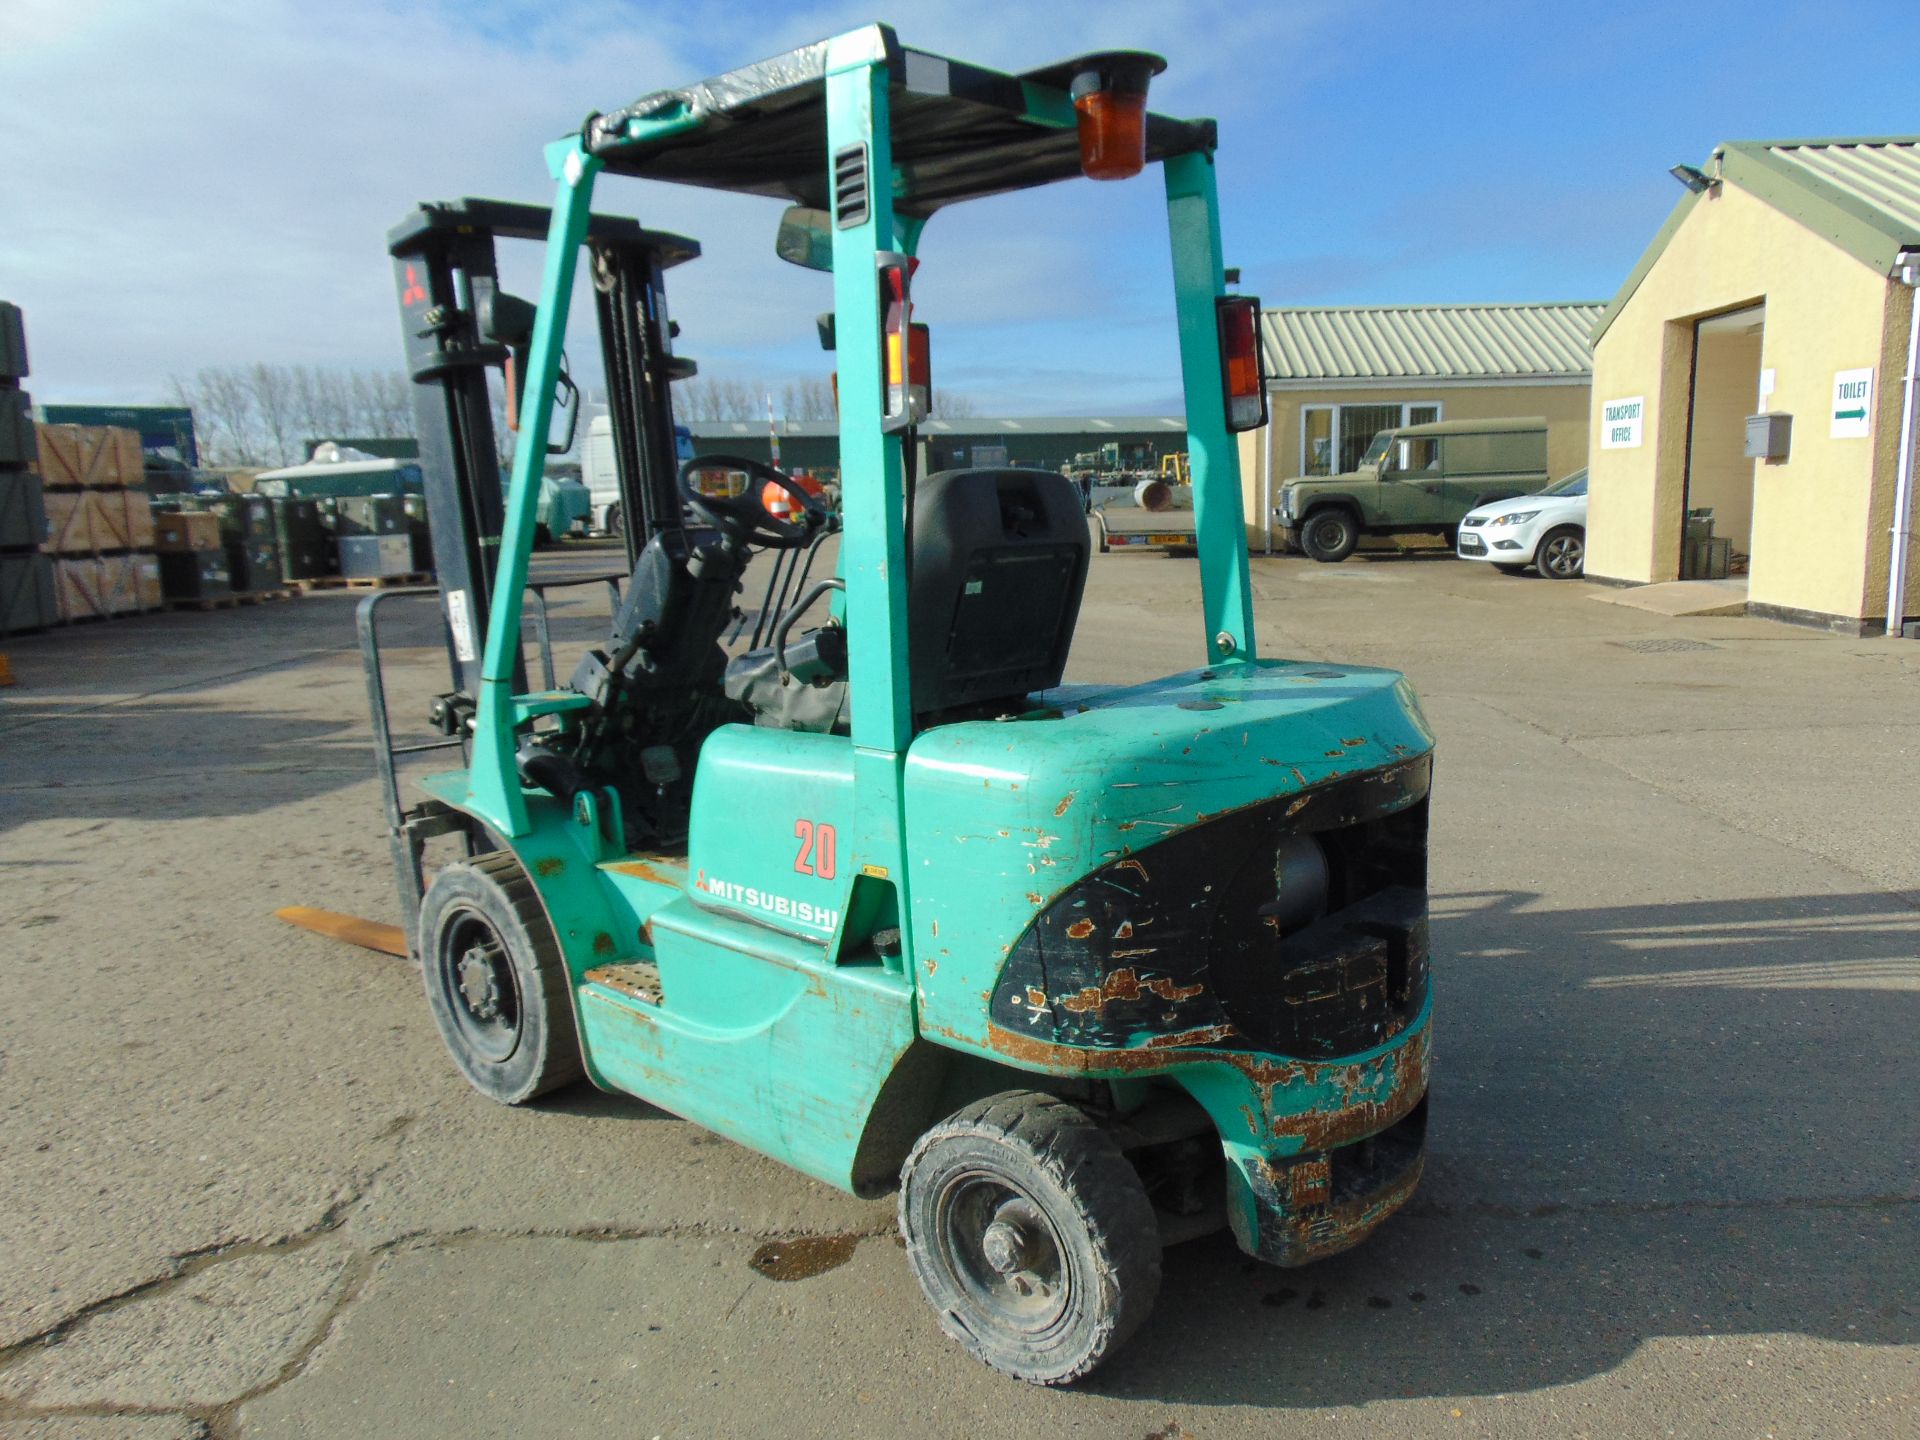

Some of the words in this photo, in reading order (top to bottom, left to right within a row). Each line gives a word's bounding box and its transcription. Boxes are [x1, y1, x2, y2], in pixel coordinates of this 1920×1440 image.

[1838, 381, 1868, 400] TOILET
[1605, 403, 1641, 422] TRANSPORT
[1611, 427, 1632, 443] OFFICE
[794, 818, 836, 881] 20
[708, 878, 839, 930] MITSUBISHI
